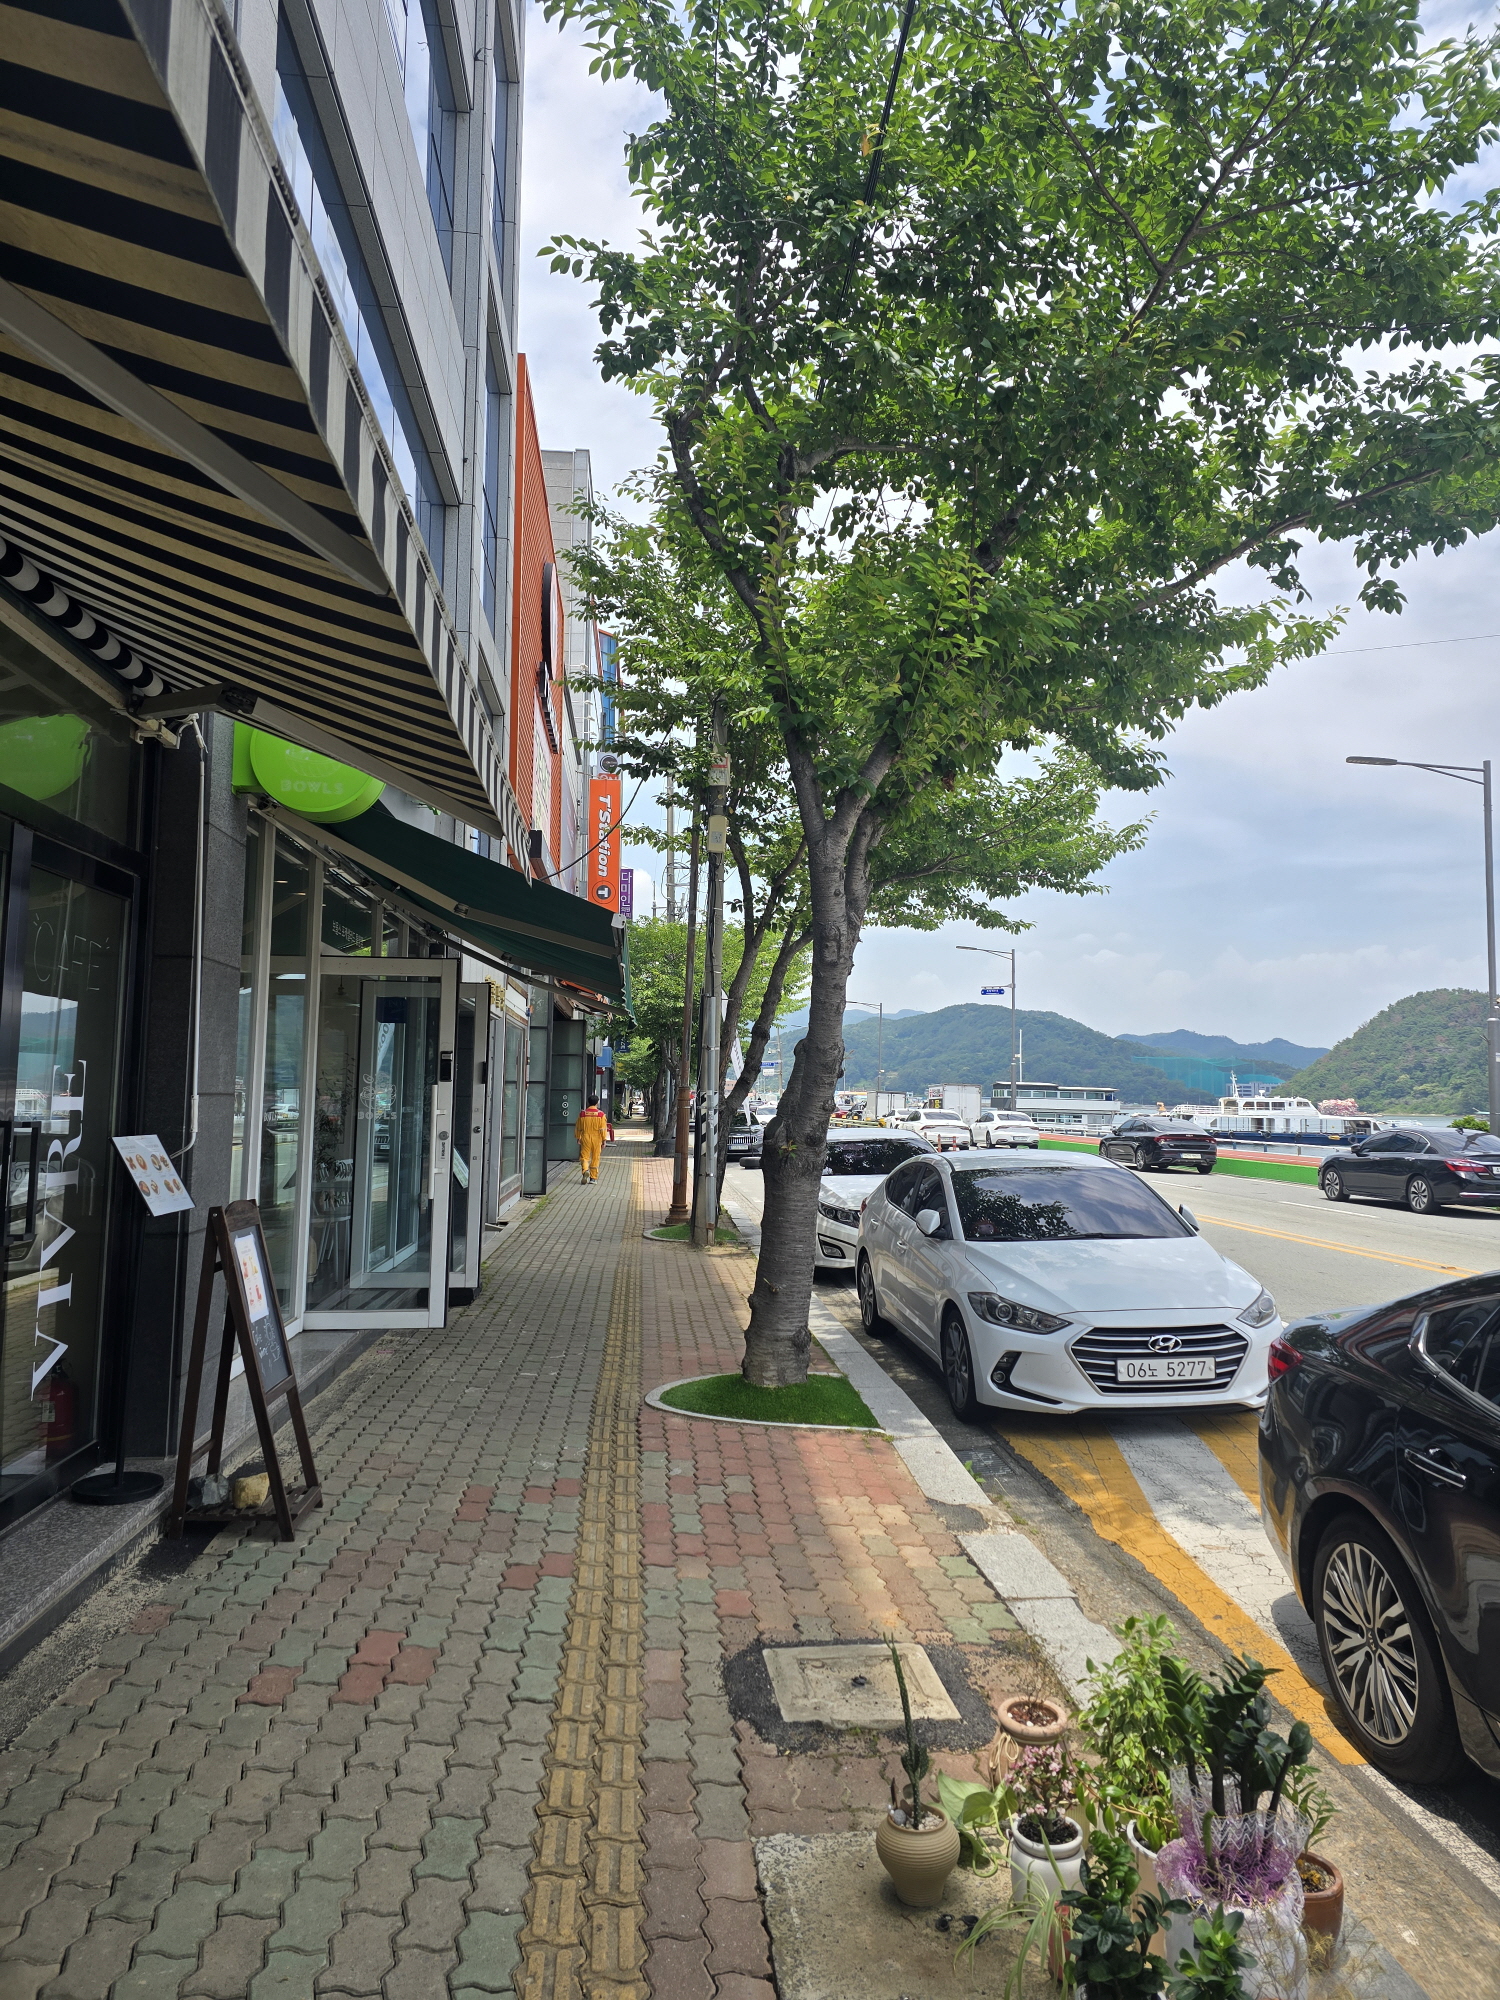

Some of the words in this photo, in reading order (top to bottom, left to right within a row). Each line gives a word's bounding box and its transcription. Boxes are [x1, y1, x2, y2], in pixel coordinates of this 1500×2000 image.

[281, 779, 344, 795] BOWLS
[598, 794, 612, 877] T'Station
[30, 1059, 87, 1402] VIVRE
[1126, 1363, 1158, 1378] 06노
[1166, 1361, 1206, 1377] 5277
